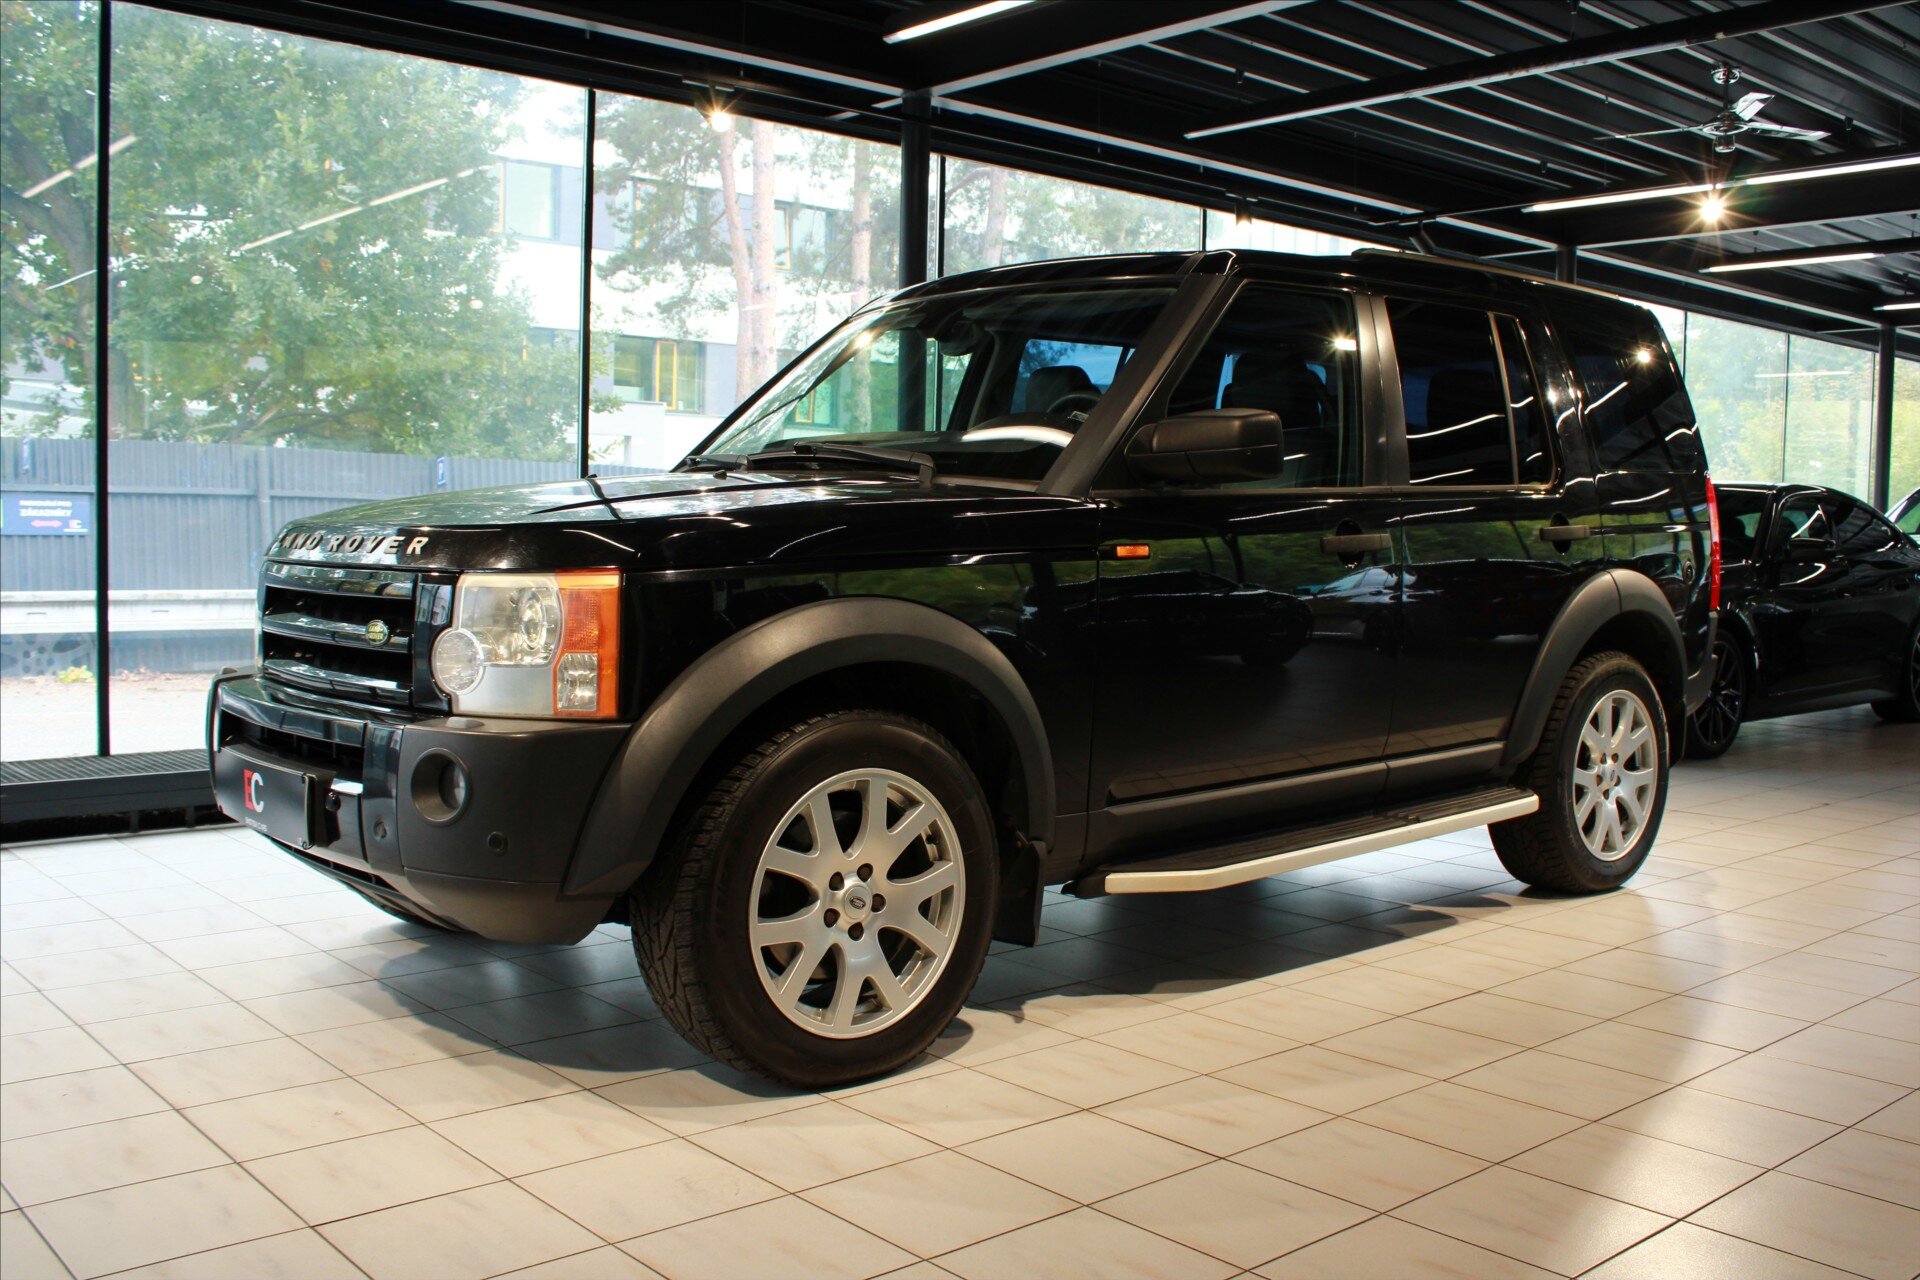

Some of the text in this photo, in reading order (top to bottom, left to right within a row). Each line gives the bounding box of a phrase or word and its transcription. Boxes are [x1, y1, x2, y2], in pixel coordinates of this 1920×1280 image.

[270, 530, 429, 555] LAND ROVER
[243, 768, 264, 813] EC
